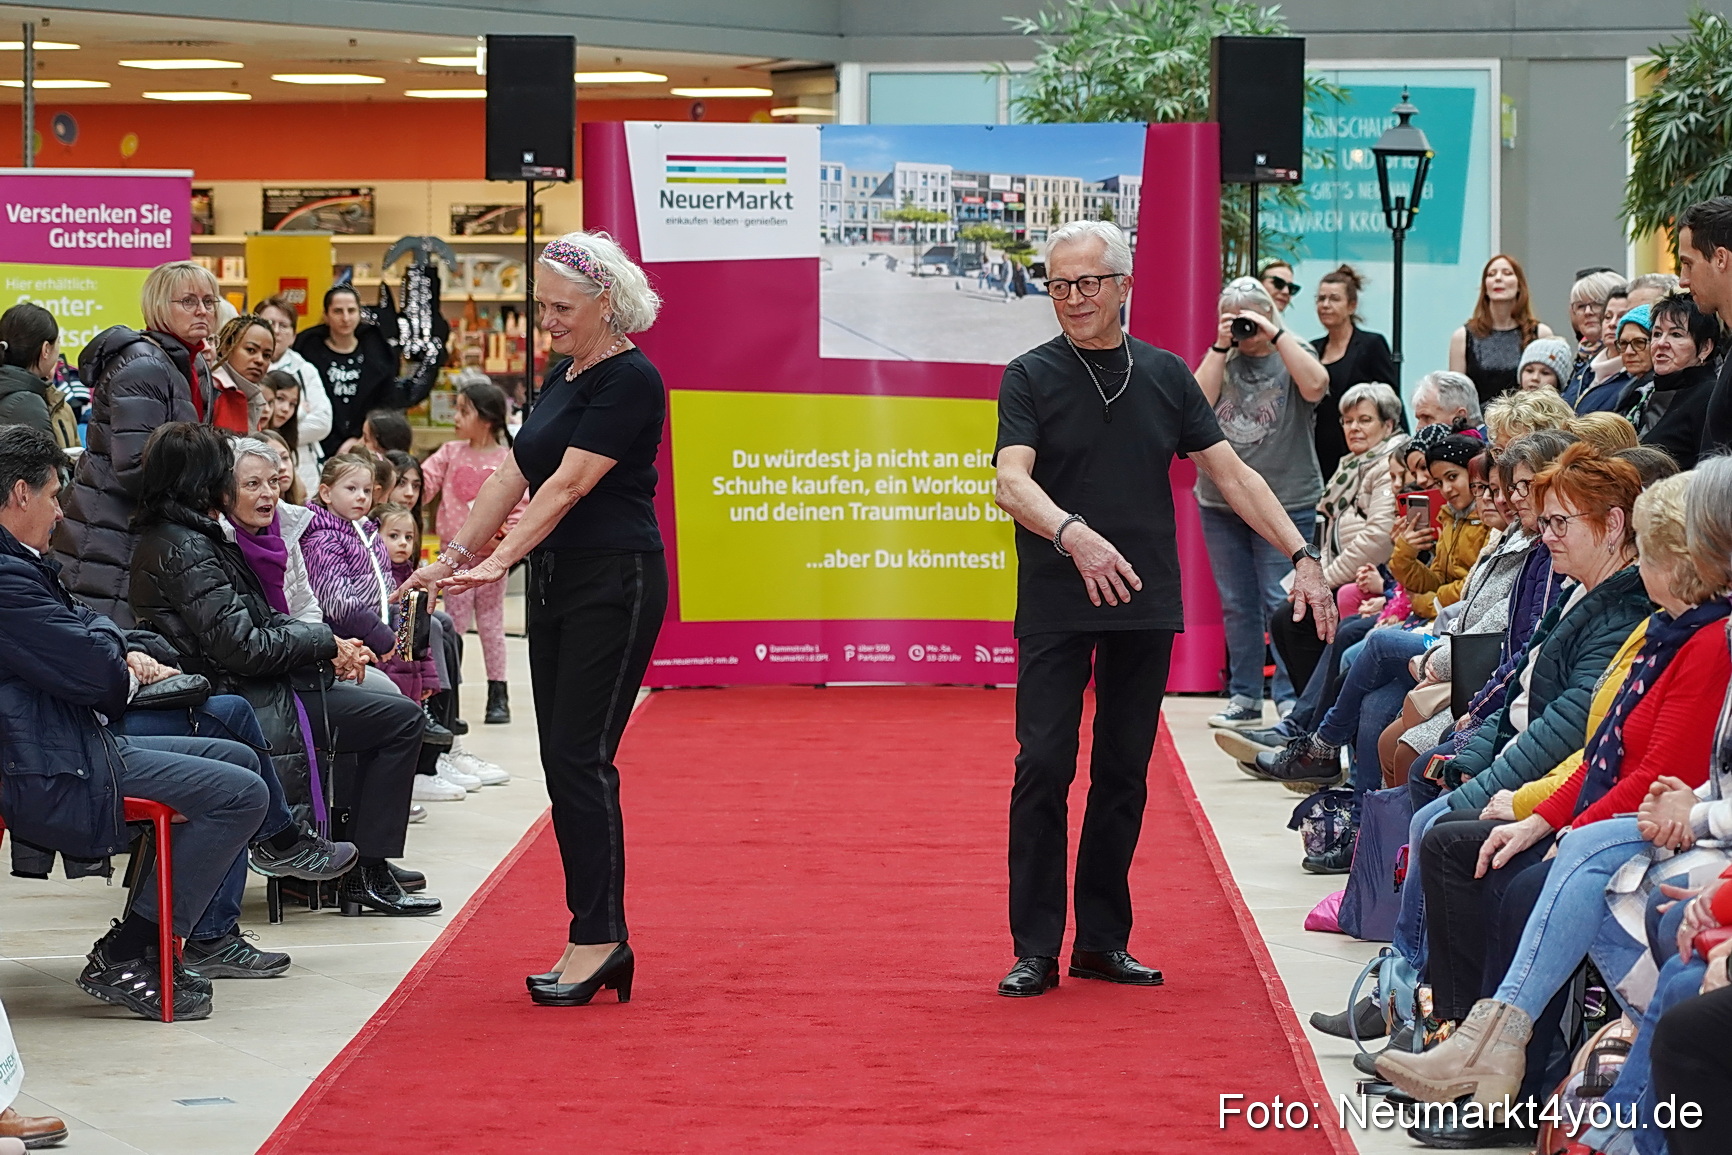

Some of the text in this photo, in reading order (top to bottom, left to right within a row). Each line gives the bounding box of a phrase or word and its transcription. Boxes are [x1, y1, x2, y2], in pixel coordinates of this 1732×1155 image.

[660, 190, 794, 210] NeuerMarkt
[6, 203, 172, 225] Verschenken Sie
[665, 217, 709, 226] einkaufen
[713, 217, 739, 226] leben
[50, 228, 172, 249] Gutscheine!
[5, 277, 98, 291] Hier erhältlich:
[733, 450, 760, 469] Du
[764, 449, 850, 469] würdest
[853, 449, 873, 472] ja
[877, 449, 929, 469] nicht
[933, 452, 959, 469] an
[712, 475, 997, 496] Schuhe kaufen, ein Workout
[730, 502, 1014, 522] und deinen Traumurlaub bu
[806, 550, 1005, 569] ...aber Du könntest!
